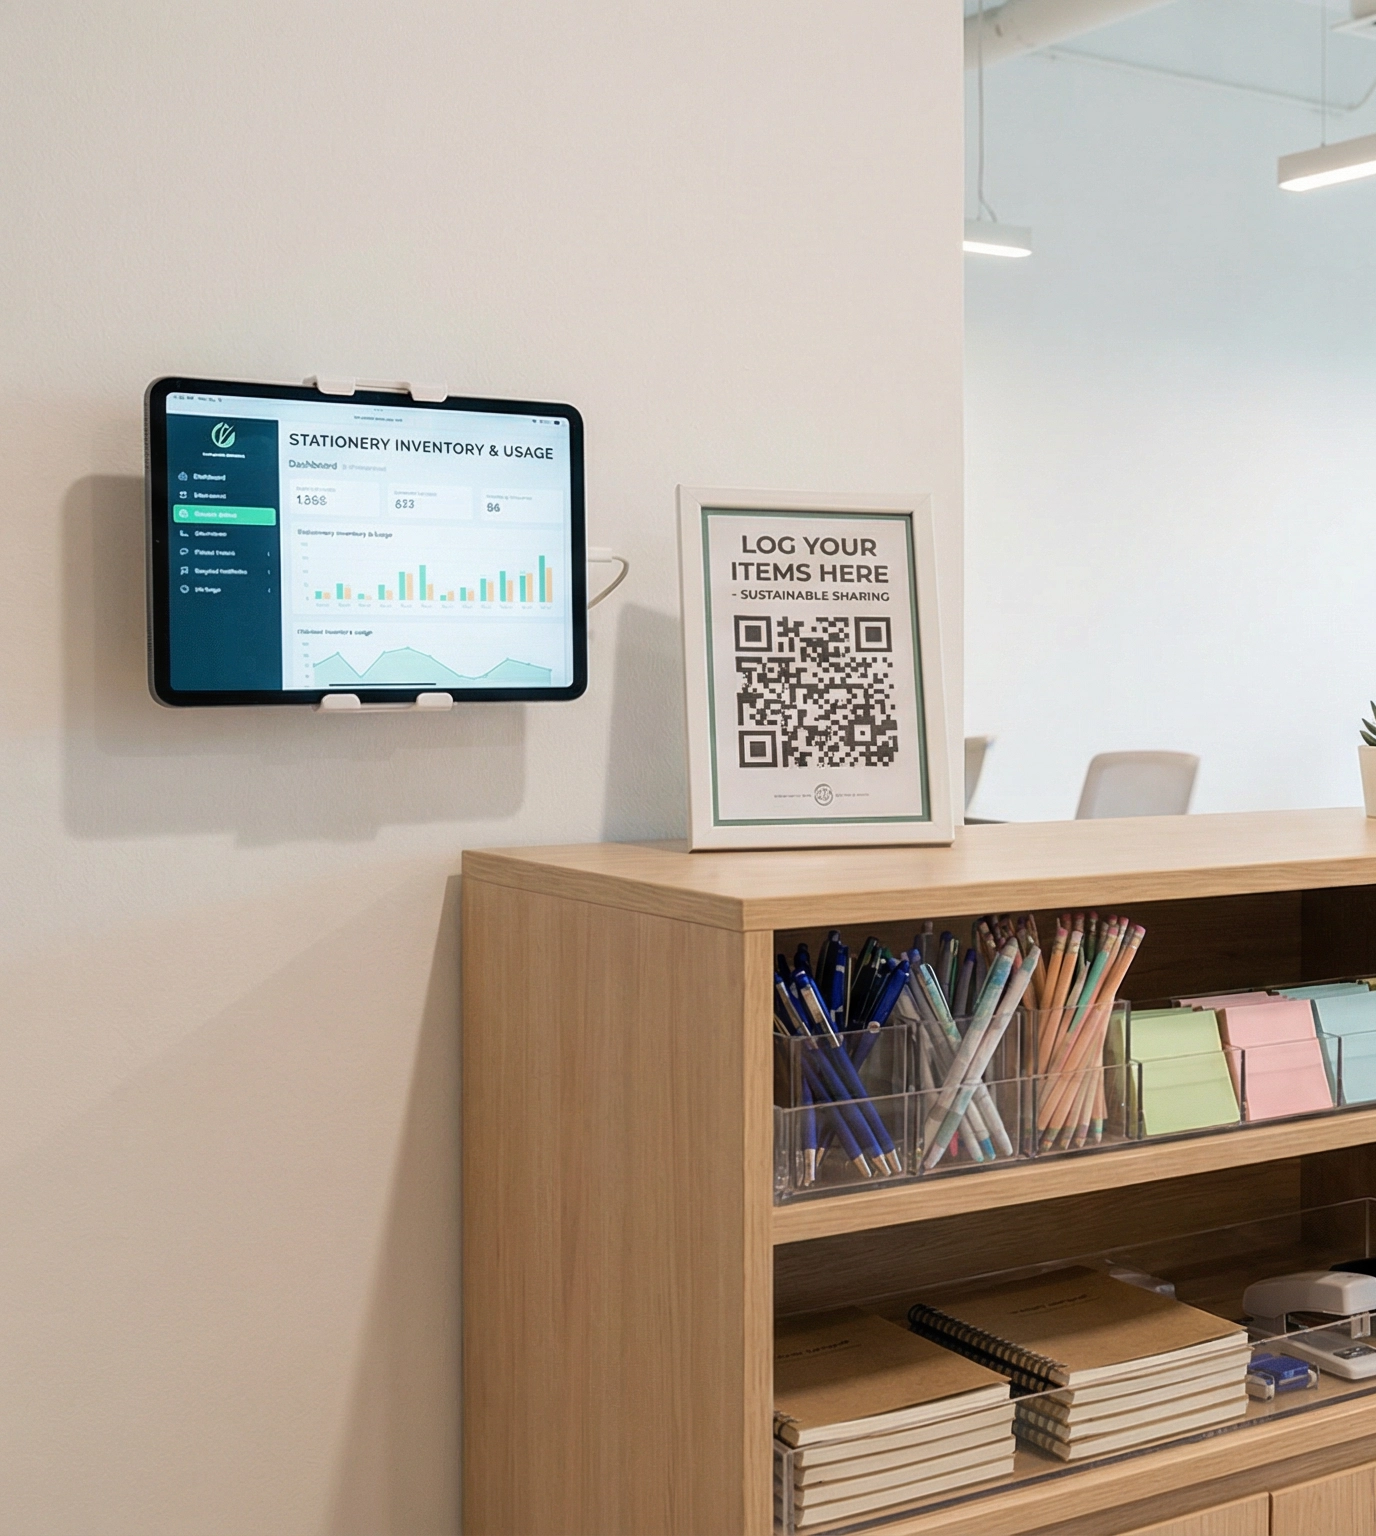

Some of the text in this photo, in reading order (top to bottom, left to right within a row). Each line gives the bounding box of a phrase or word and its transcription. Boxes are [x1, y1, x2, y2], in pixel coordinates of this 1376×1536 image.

[289, 433, 553, 460] STATIONERY INVENTORY & USAGE
[742, 535, 877, 557] LOG YOUR
[731, 561, 889, 583] ITEMS HERE
[740, 589, 829, 601] SUSTAINABLE
[832, 591, 890, 602] SHARING
